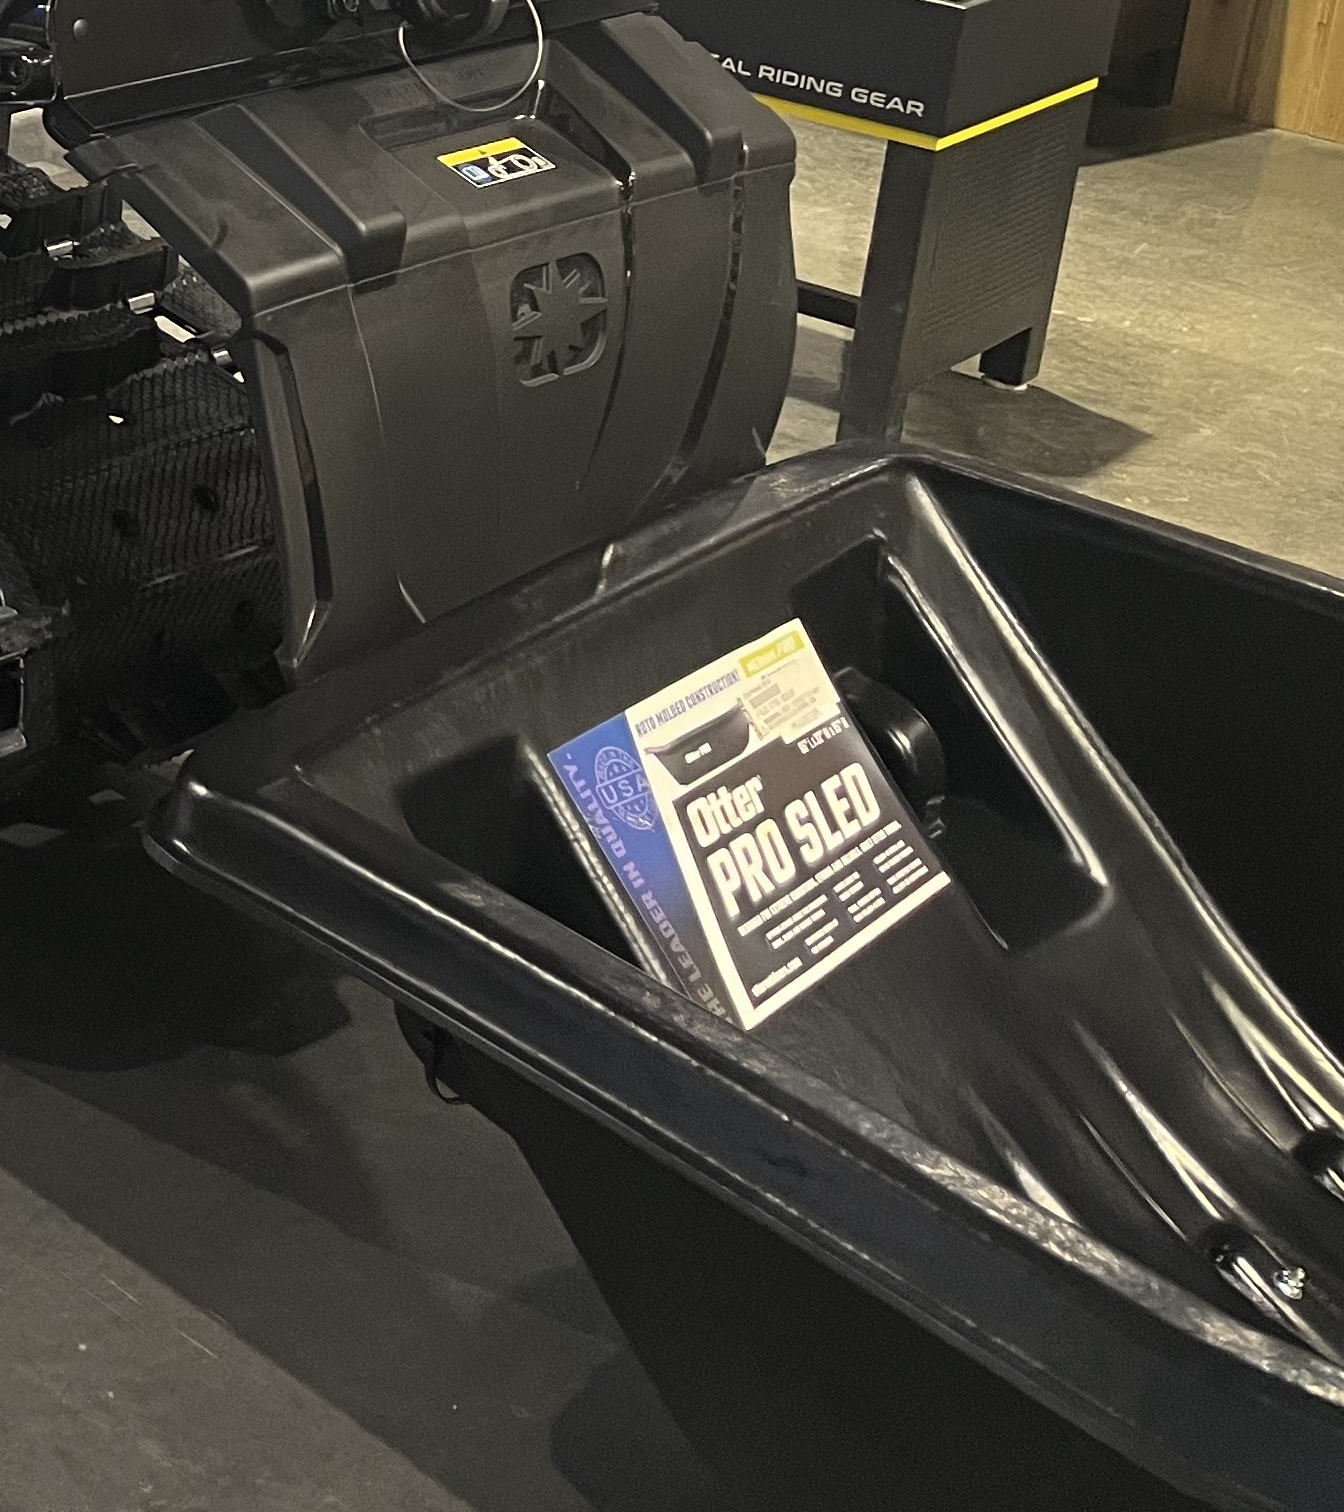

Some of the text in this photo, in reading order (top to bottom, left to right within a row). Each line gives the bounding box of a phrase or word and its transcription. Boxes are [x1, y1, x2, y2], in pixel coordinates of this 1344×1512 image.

[758, 64, 844, 98] RIDING
[850, 86, 925, 118] GEAR
[600, 773, 649, 804] USA
[686, 776, 765, 848] Otter
[706, 818, 796, 918] PRO
[784, 762, 881, 863] SLED
[623, 861, 645, 889] IN
[640, 890, 702, 982] LEADER
